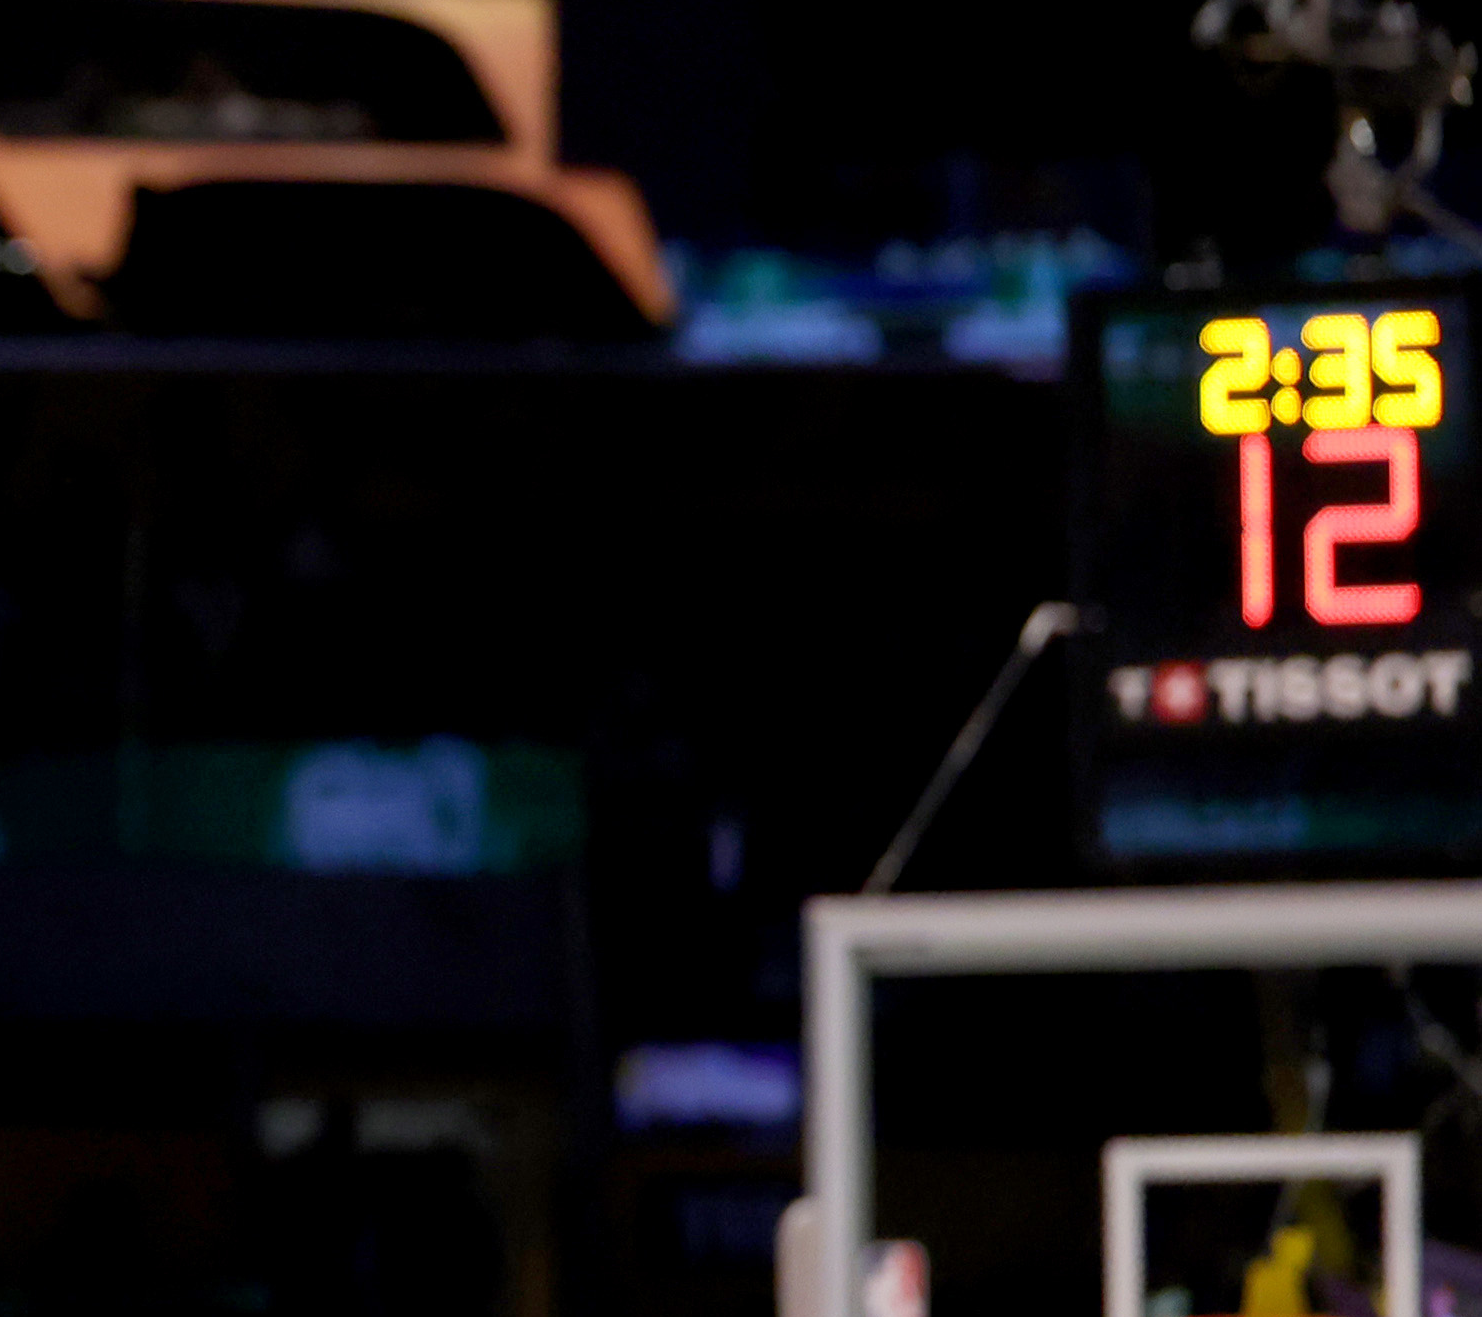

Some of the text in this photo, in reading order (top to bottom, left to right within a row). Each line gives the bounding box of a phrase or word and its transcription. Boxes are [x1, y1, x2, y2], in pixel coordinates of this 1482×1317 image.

[1199, 309, 1443, 436] 2:35
[1239, 423, 1423, 628] 12
[1207, 649, 1472, 723] TISSOT
